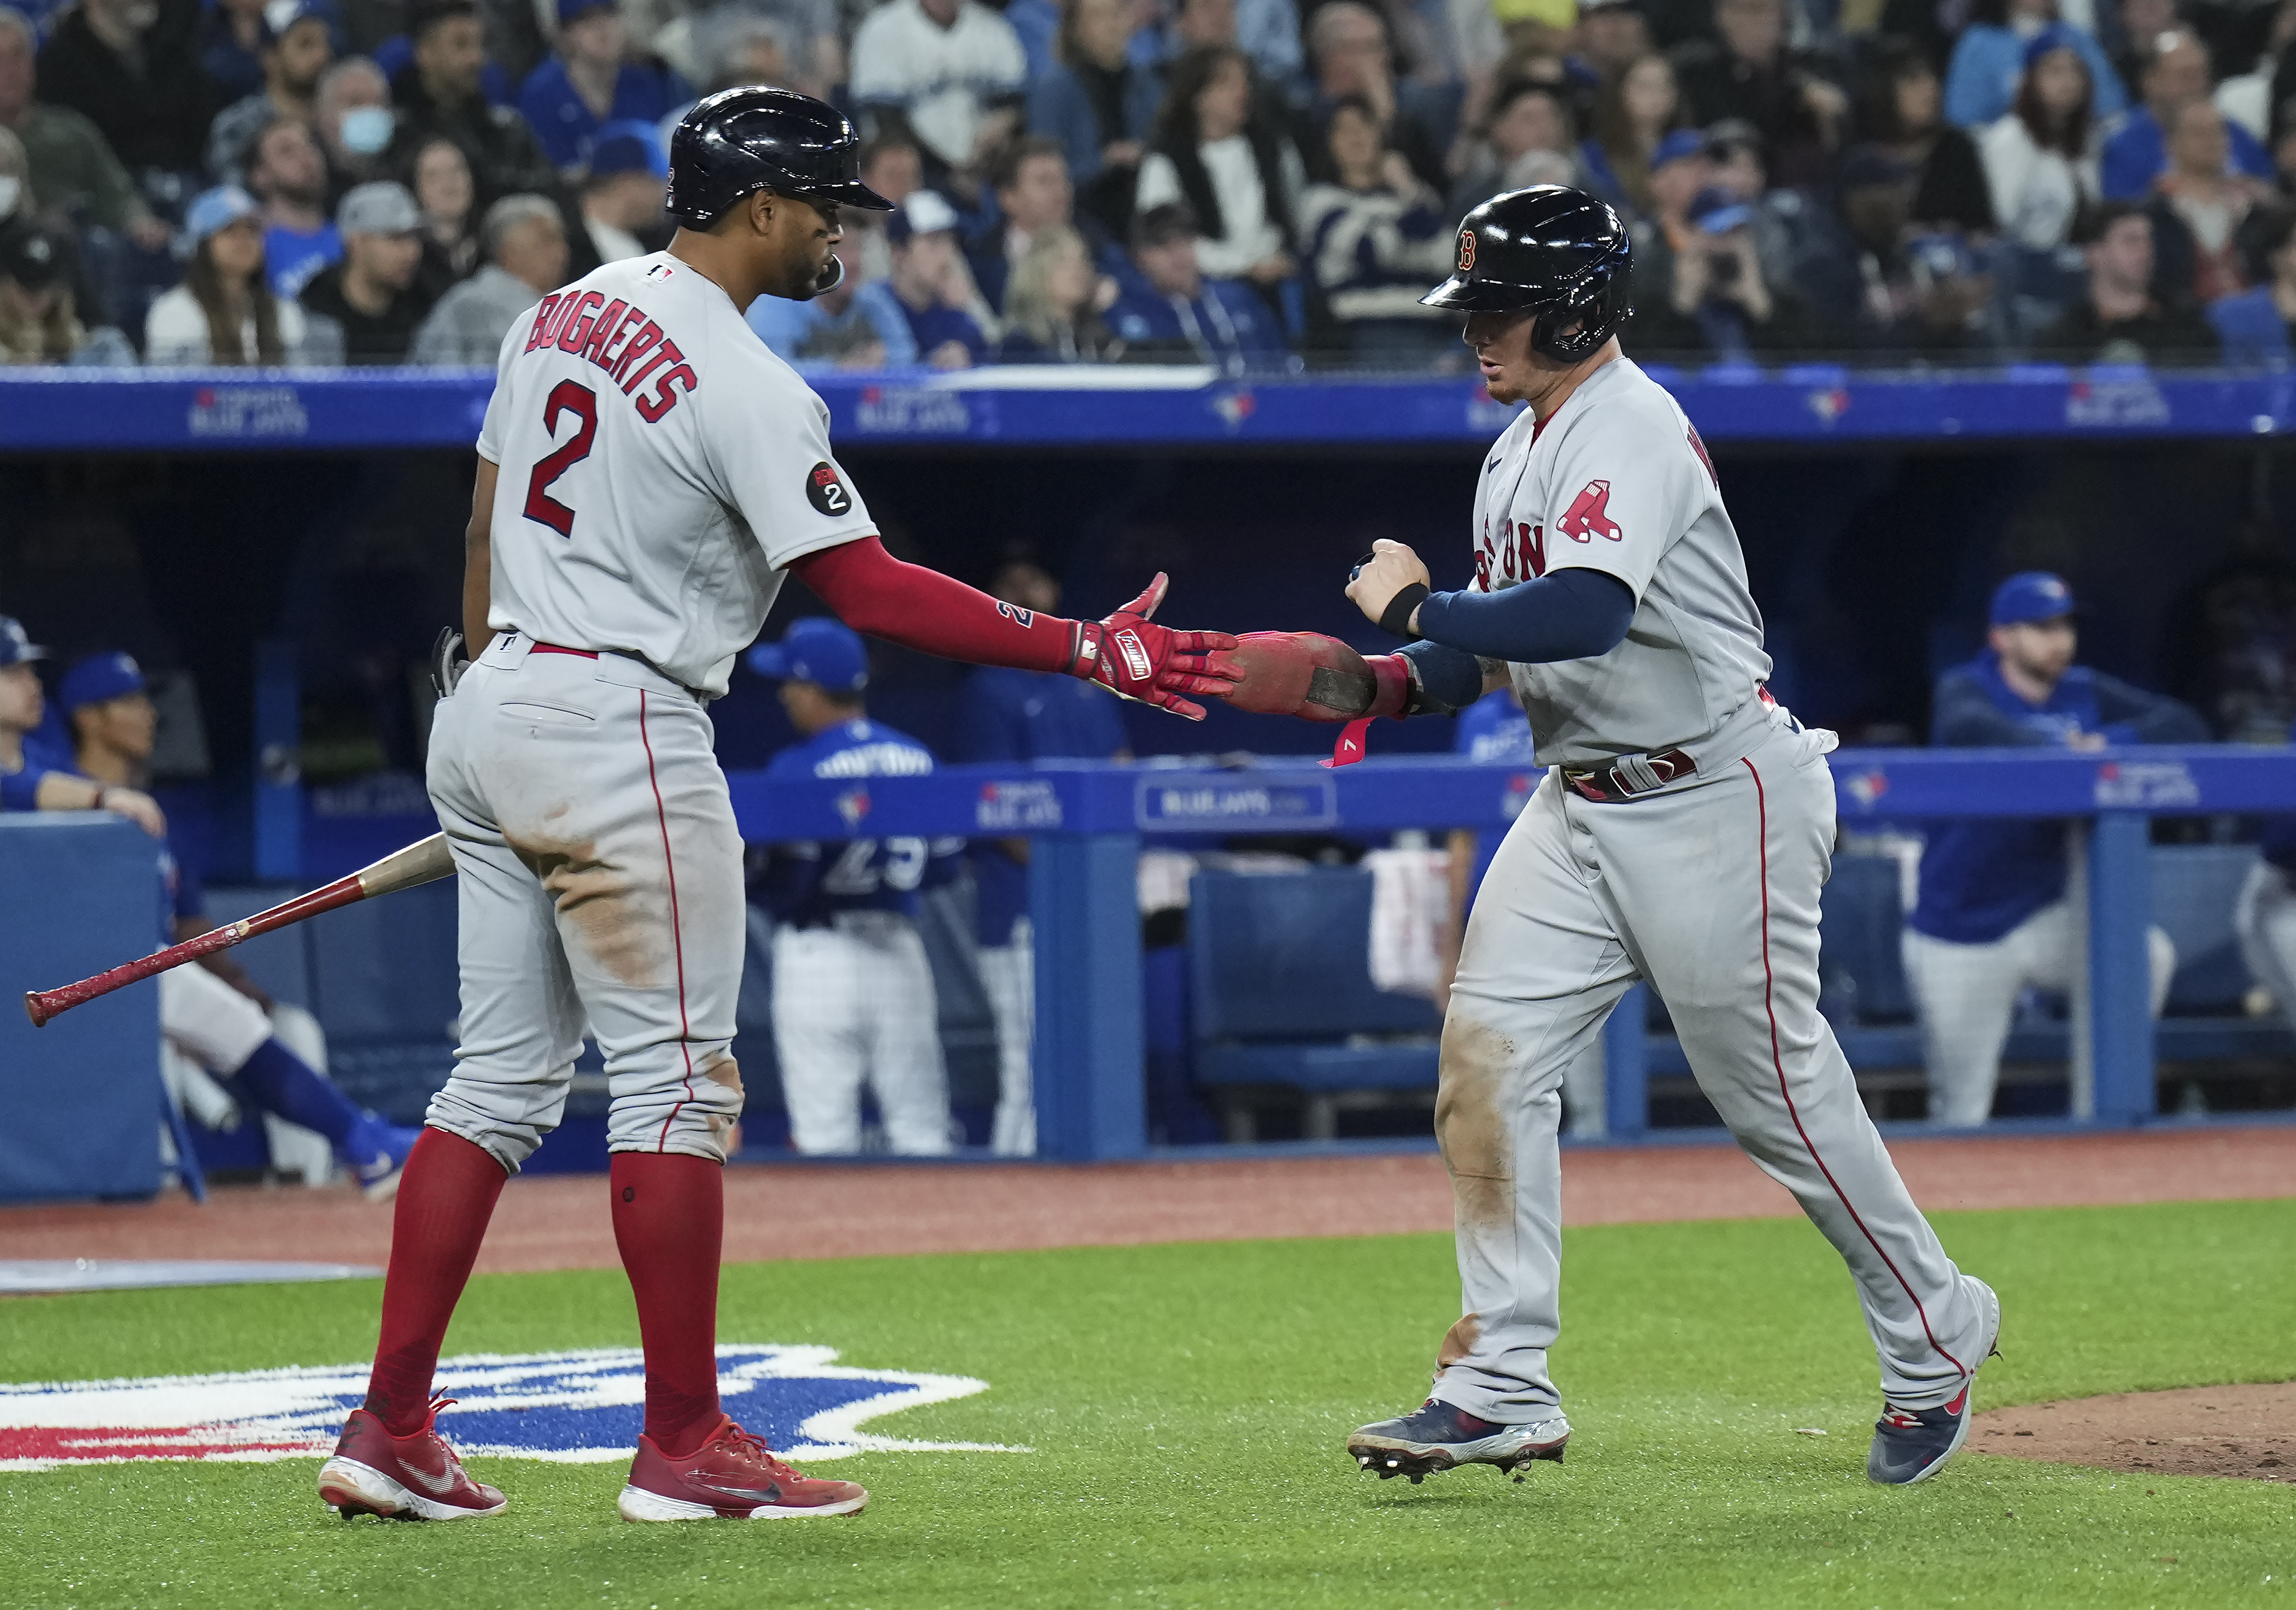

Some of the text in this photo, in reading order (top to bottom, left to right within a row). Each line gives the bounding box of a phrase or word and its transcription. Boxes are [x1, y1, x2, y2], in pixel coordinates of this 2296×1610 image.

[1458, 229, 1477, 271] B
[523, 290, 698, 424] BOGAERTS
[522, 378, 598, 539] 2
[824, 483, 847, 510] 2
[995, 600, 1034, 630] 2
[1115, 633, 1149, 676] Franklin
